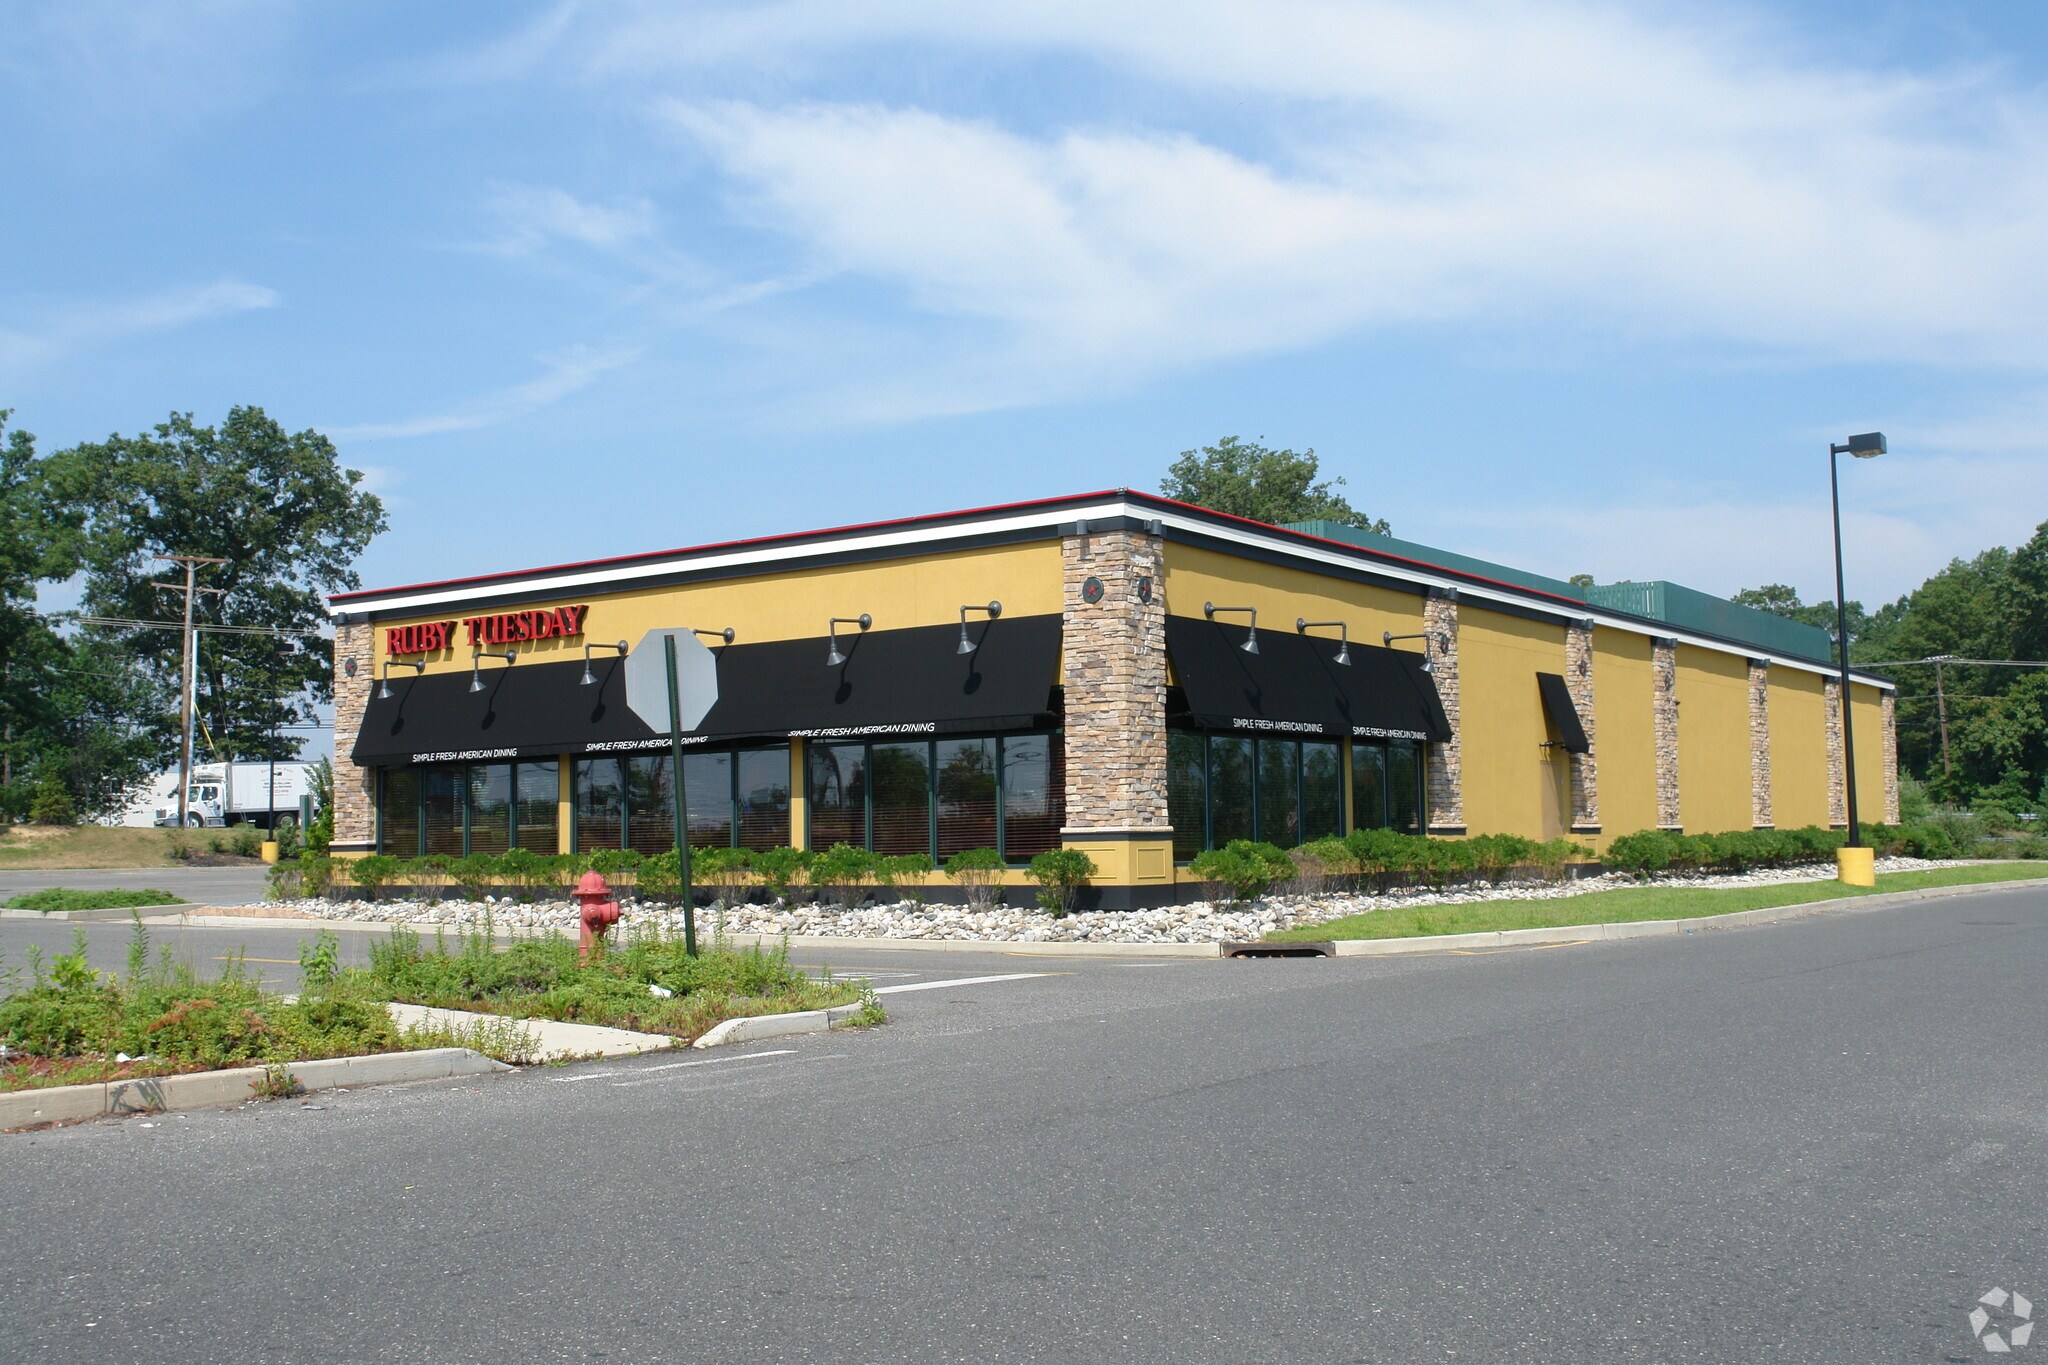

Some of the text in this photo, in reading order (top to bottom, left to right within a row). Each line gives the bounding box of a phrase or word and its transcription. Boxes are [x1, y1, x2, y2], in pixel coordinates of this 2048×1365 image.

[385, 605, 588, 655] RUBY TUESDAY
[787, 722, 935, 737] SIMPLE FRESH AMERICAN DINING
[1233, 718, 1323, 732] SIMPLE FRESH AMERICAN DINING
[1352, 726, 1427, 740] SIMPLE FRESH AMERICAN DINING
[585, 736, 708, 751] SIMPLE FRESH AMERICA DINING
[412, 748, 517, 762] SIMPLE FRESH AMERICAN DINING
